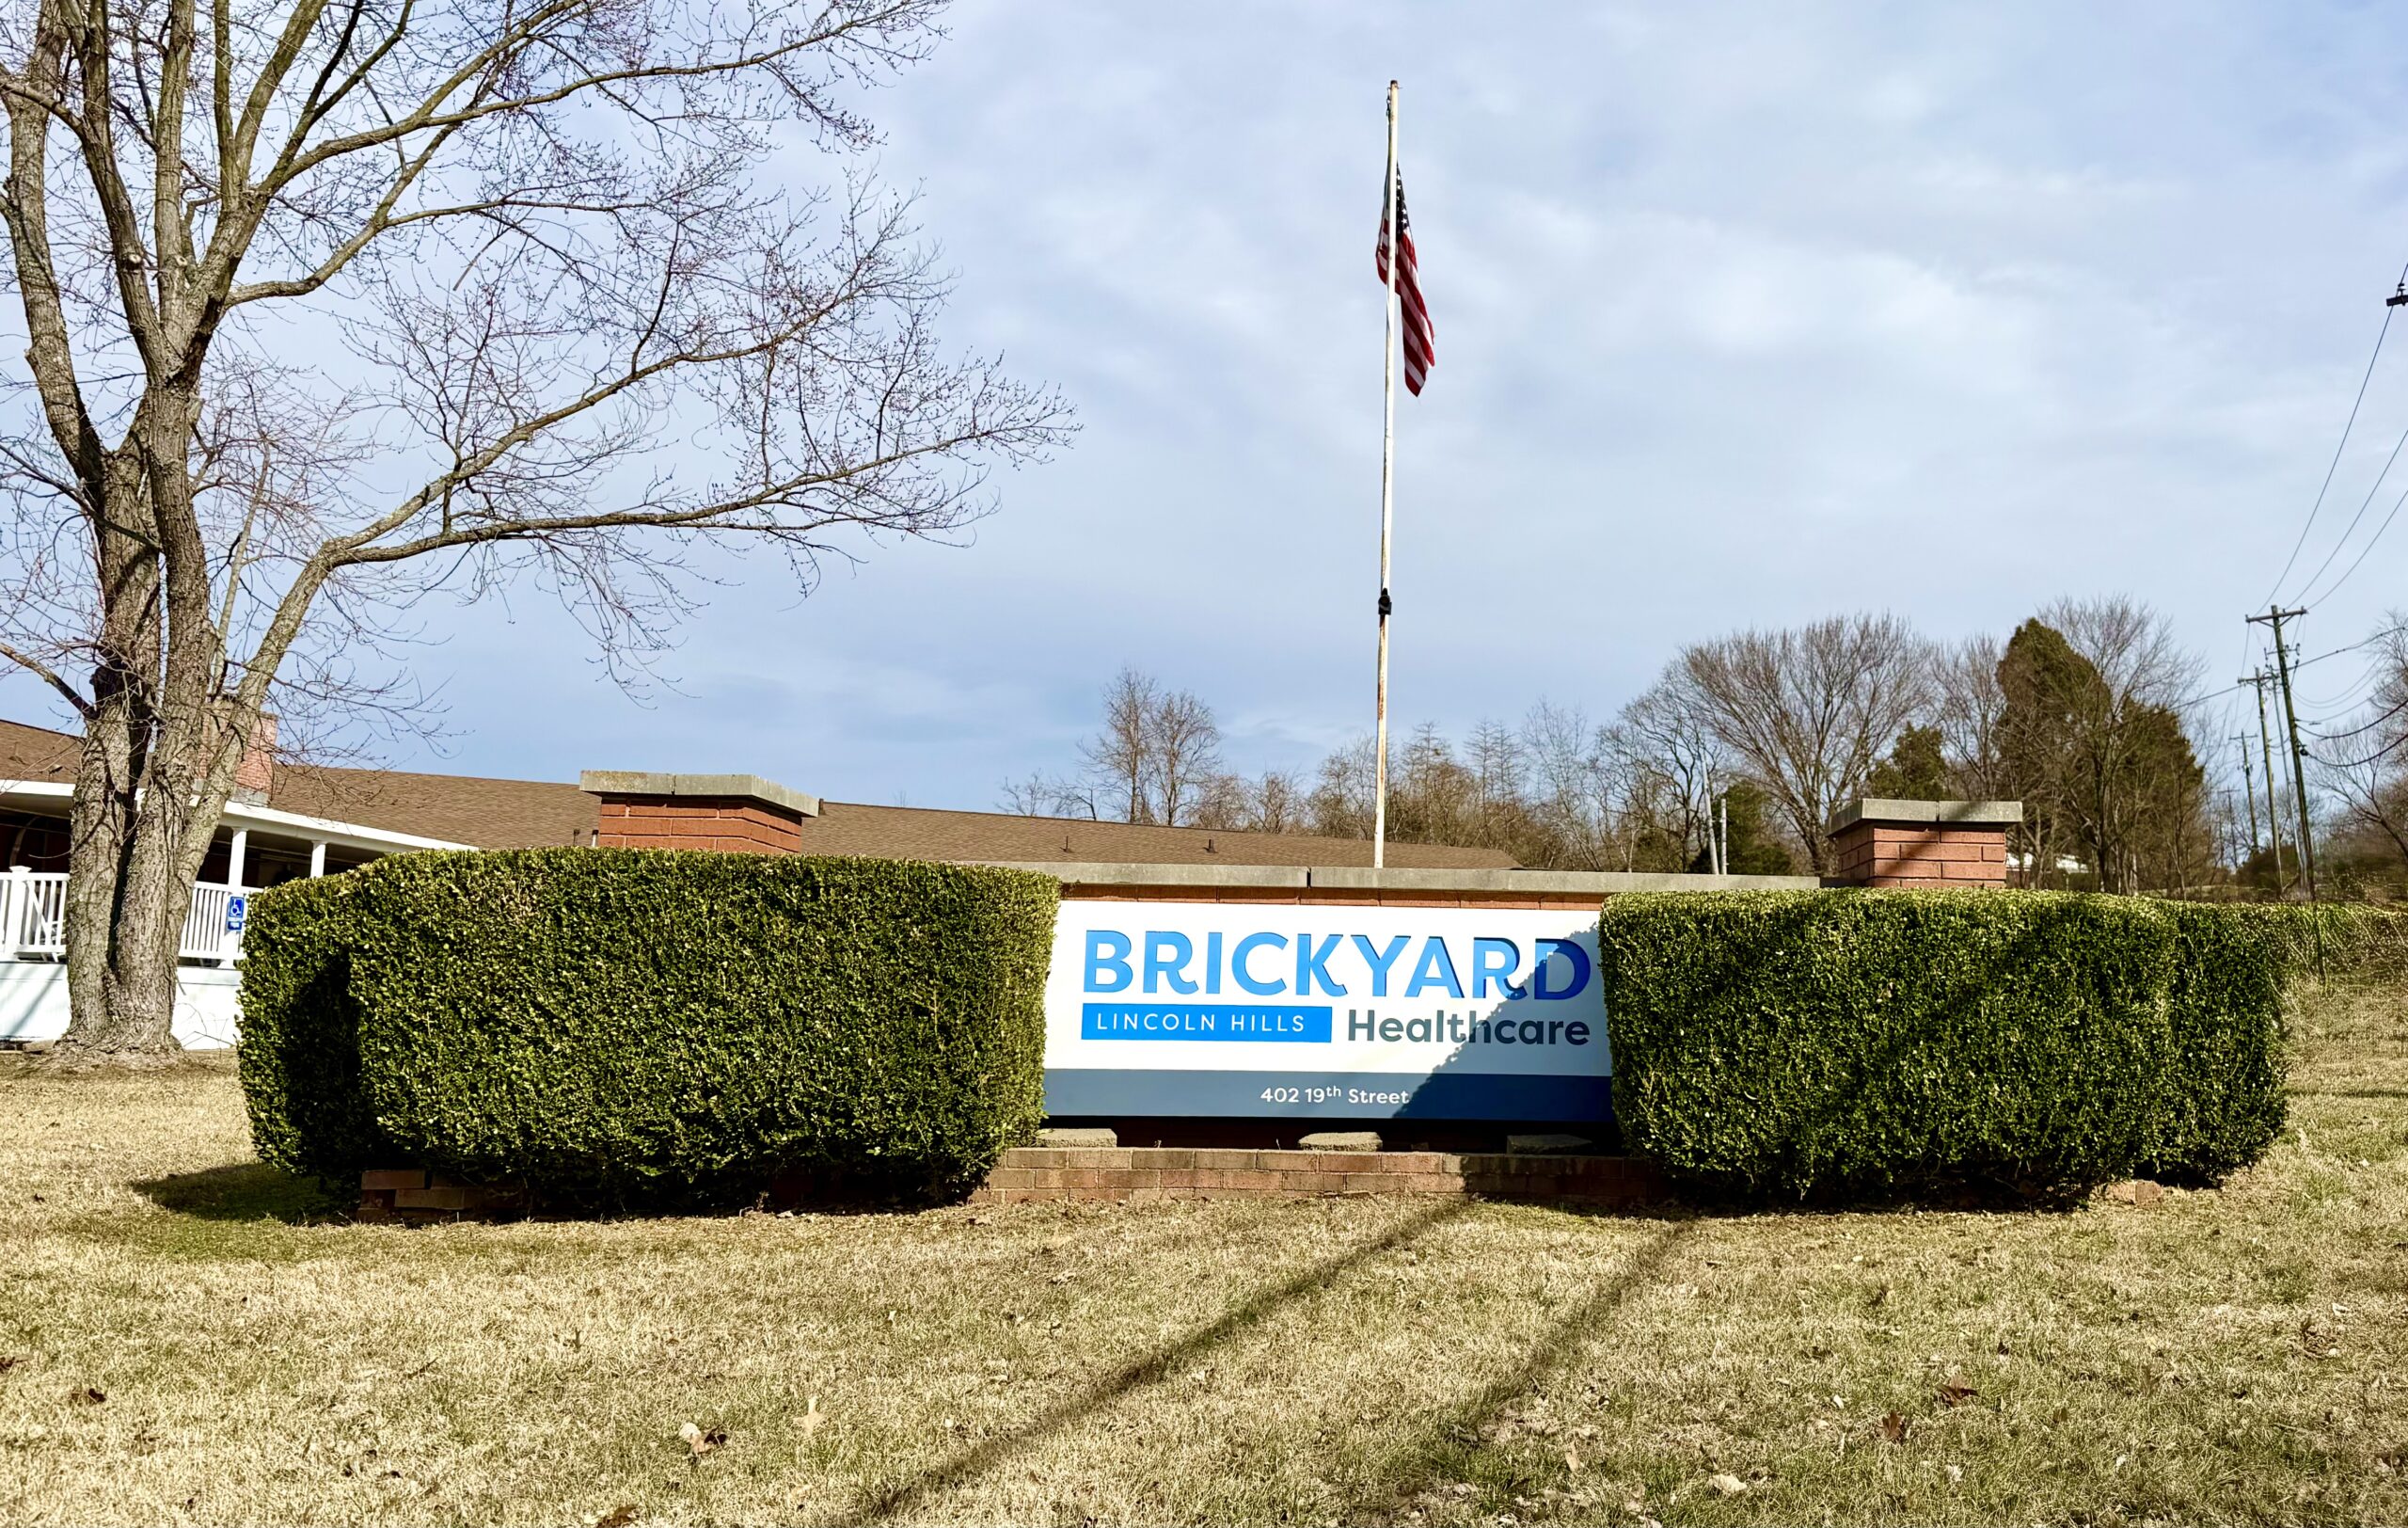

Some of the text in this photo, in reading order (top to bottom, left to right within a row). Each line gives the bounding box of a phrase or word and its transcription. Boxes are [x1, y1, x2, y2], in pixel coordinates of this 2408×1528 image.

[1084, 930, 1591, 1000] BRICKYARD
[1097, 1012, 1306, 1033] LINCOLN HILLS
[1348, 1009, 1591, 1045] Healthcare
[1259, 1085, 1410, 1106] 402 19th Street
